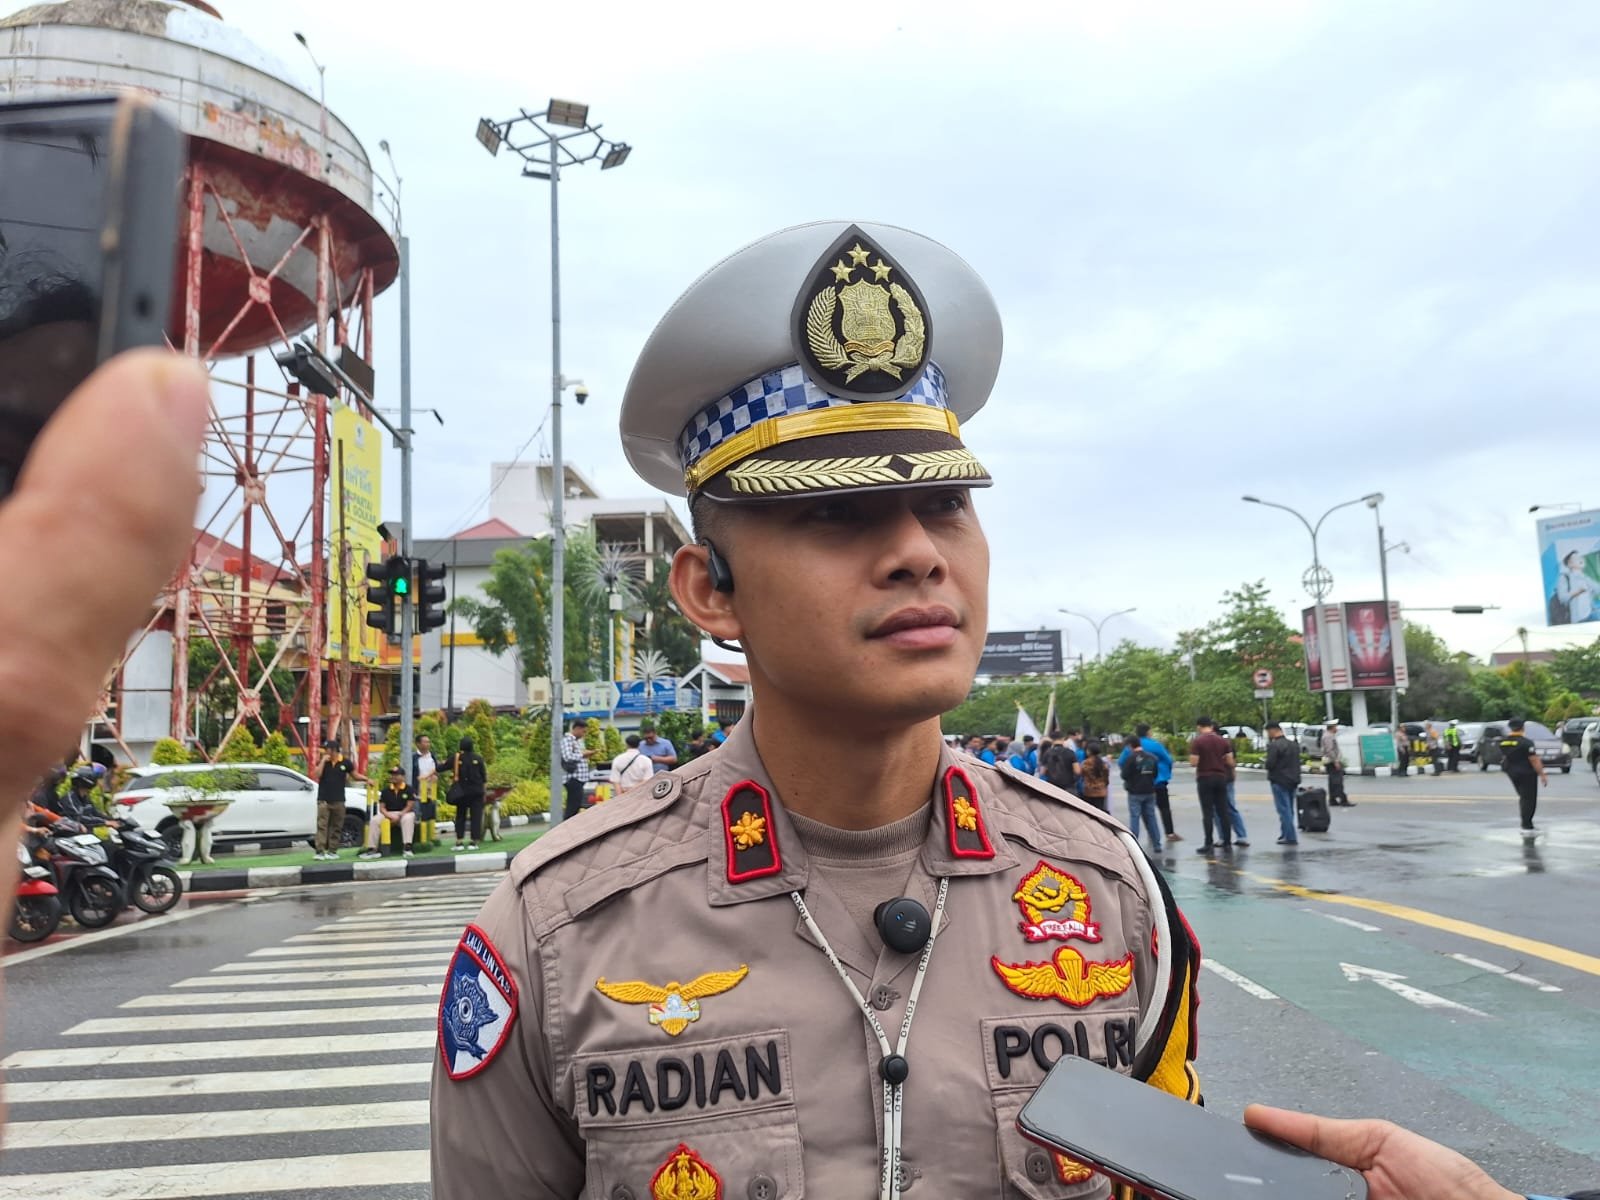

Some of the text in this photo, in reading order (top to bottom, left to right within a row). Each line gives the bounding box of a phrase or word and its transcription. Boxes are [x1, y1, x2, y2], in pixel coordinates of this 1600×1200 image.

[936, 875, 949, 910] OX40
[466, 932, 511, 993] LALU LINTAS
[918, 936, 935, 972] FOX40
[900, 1000, 916, 1039] FOX40
[994, 1017, 1136, 1080] POLRI
[586, 1040, 782, 1117] RADIAN
